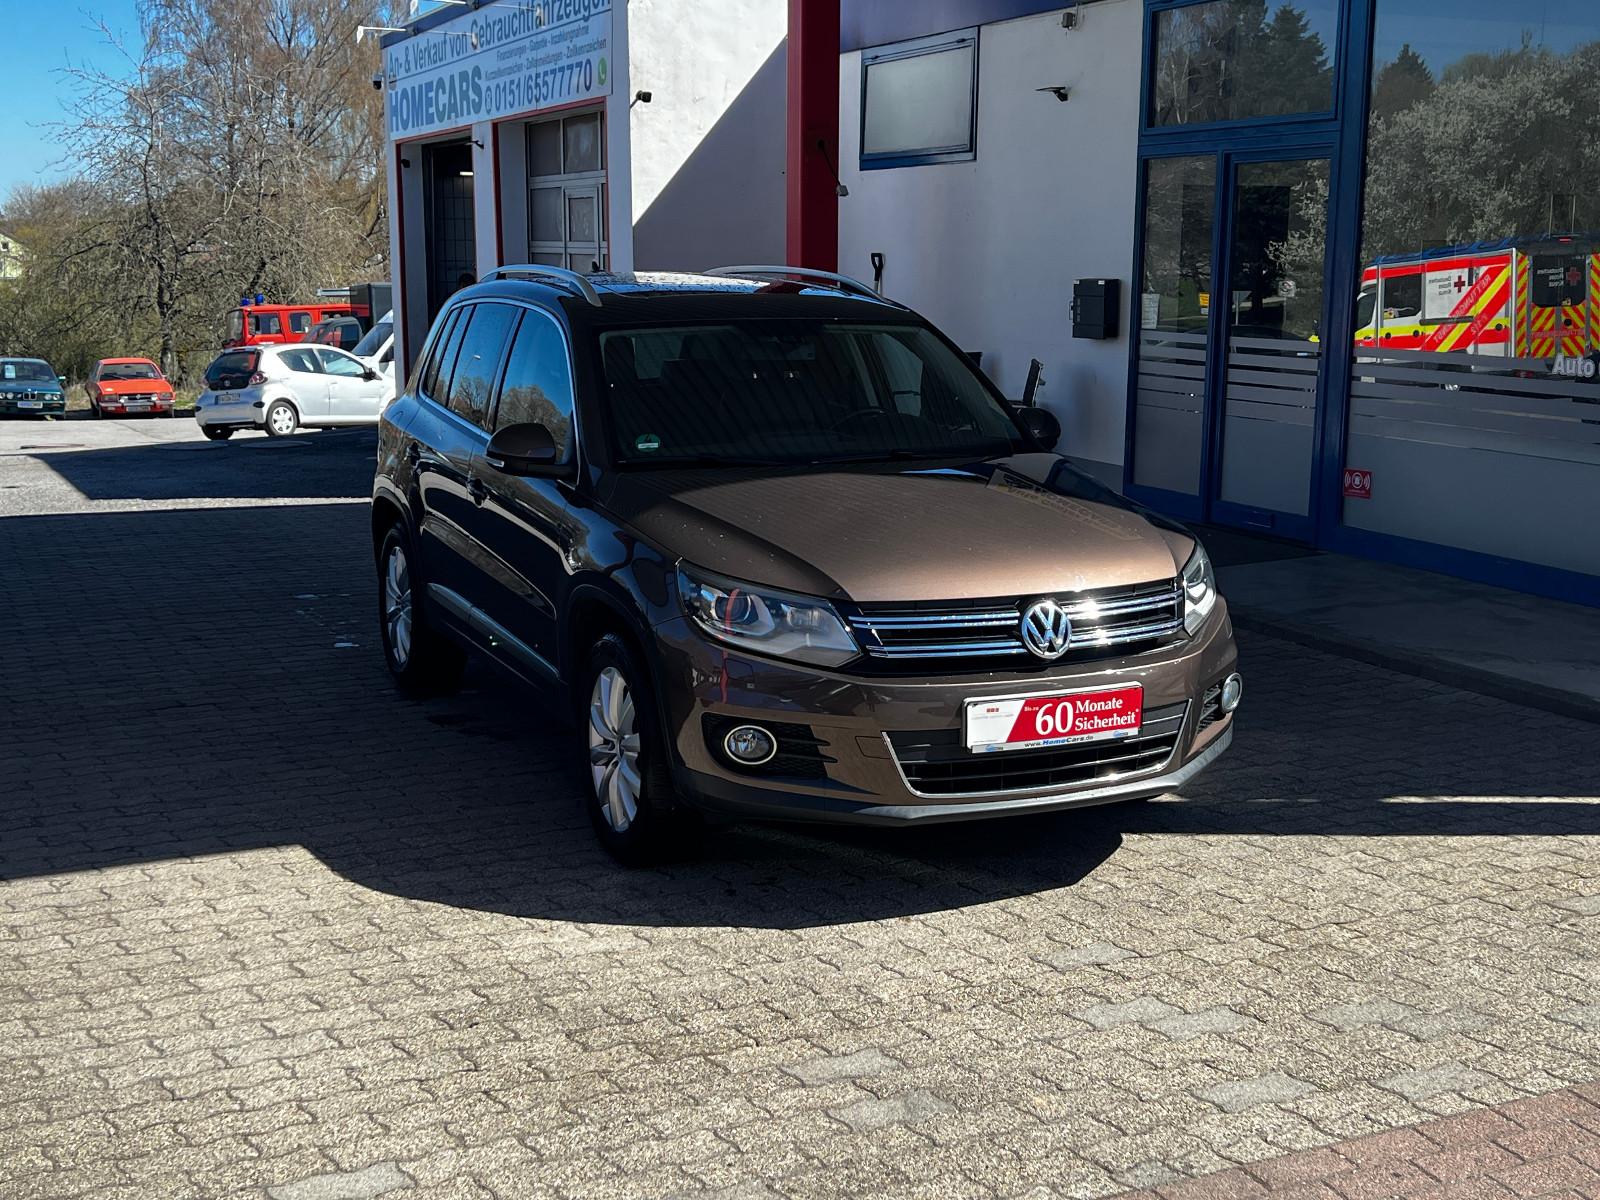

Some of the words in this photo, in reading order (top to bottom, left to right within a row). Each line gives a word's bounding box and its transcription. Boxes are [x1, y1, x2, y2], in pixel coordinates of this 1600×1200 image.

[404, 46, 411, 73] &
[412, 32, 448, 71] Verkauf
[449, 33, 467, 58] von
[389, 65, 483, 132] HOMECARS
[494, 58, 592, 112] 0151/65577770
[1551, 352, 1595, 378] Auto
[1035, 702, 1074, 735] 60
[1075, 697, 1124, 714] Monate
